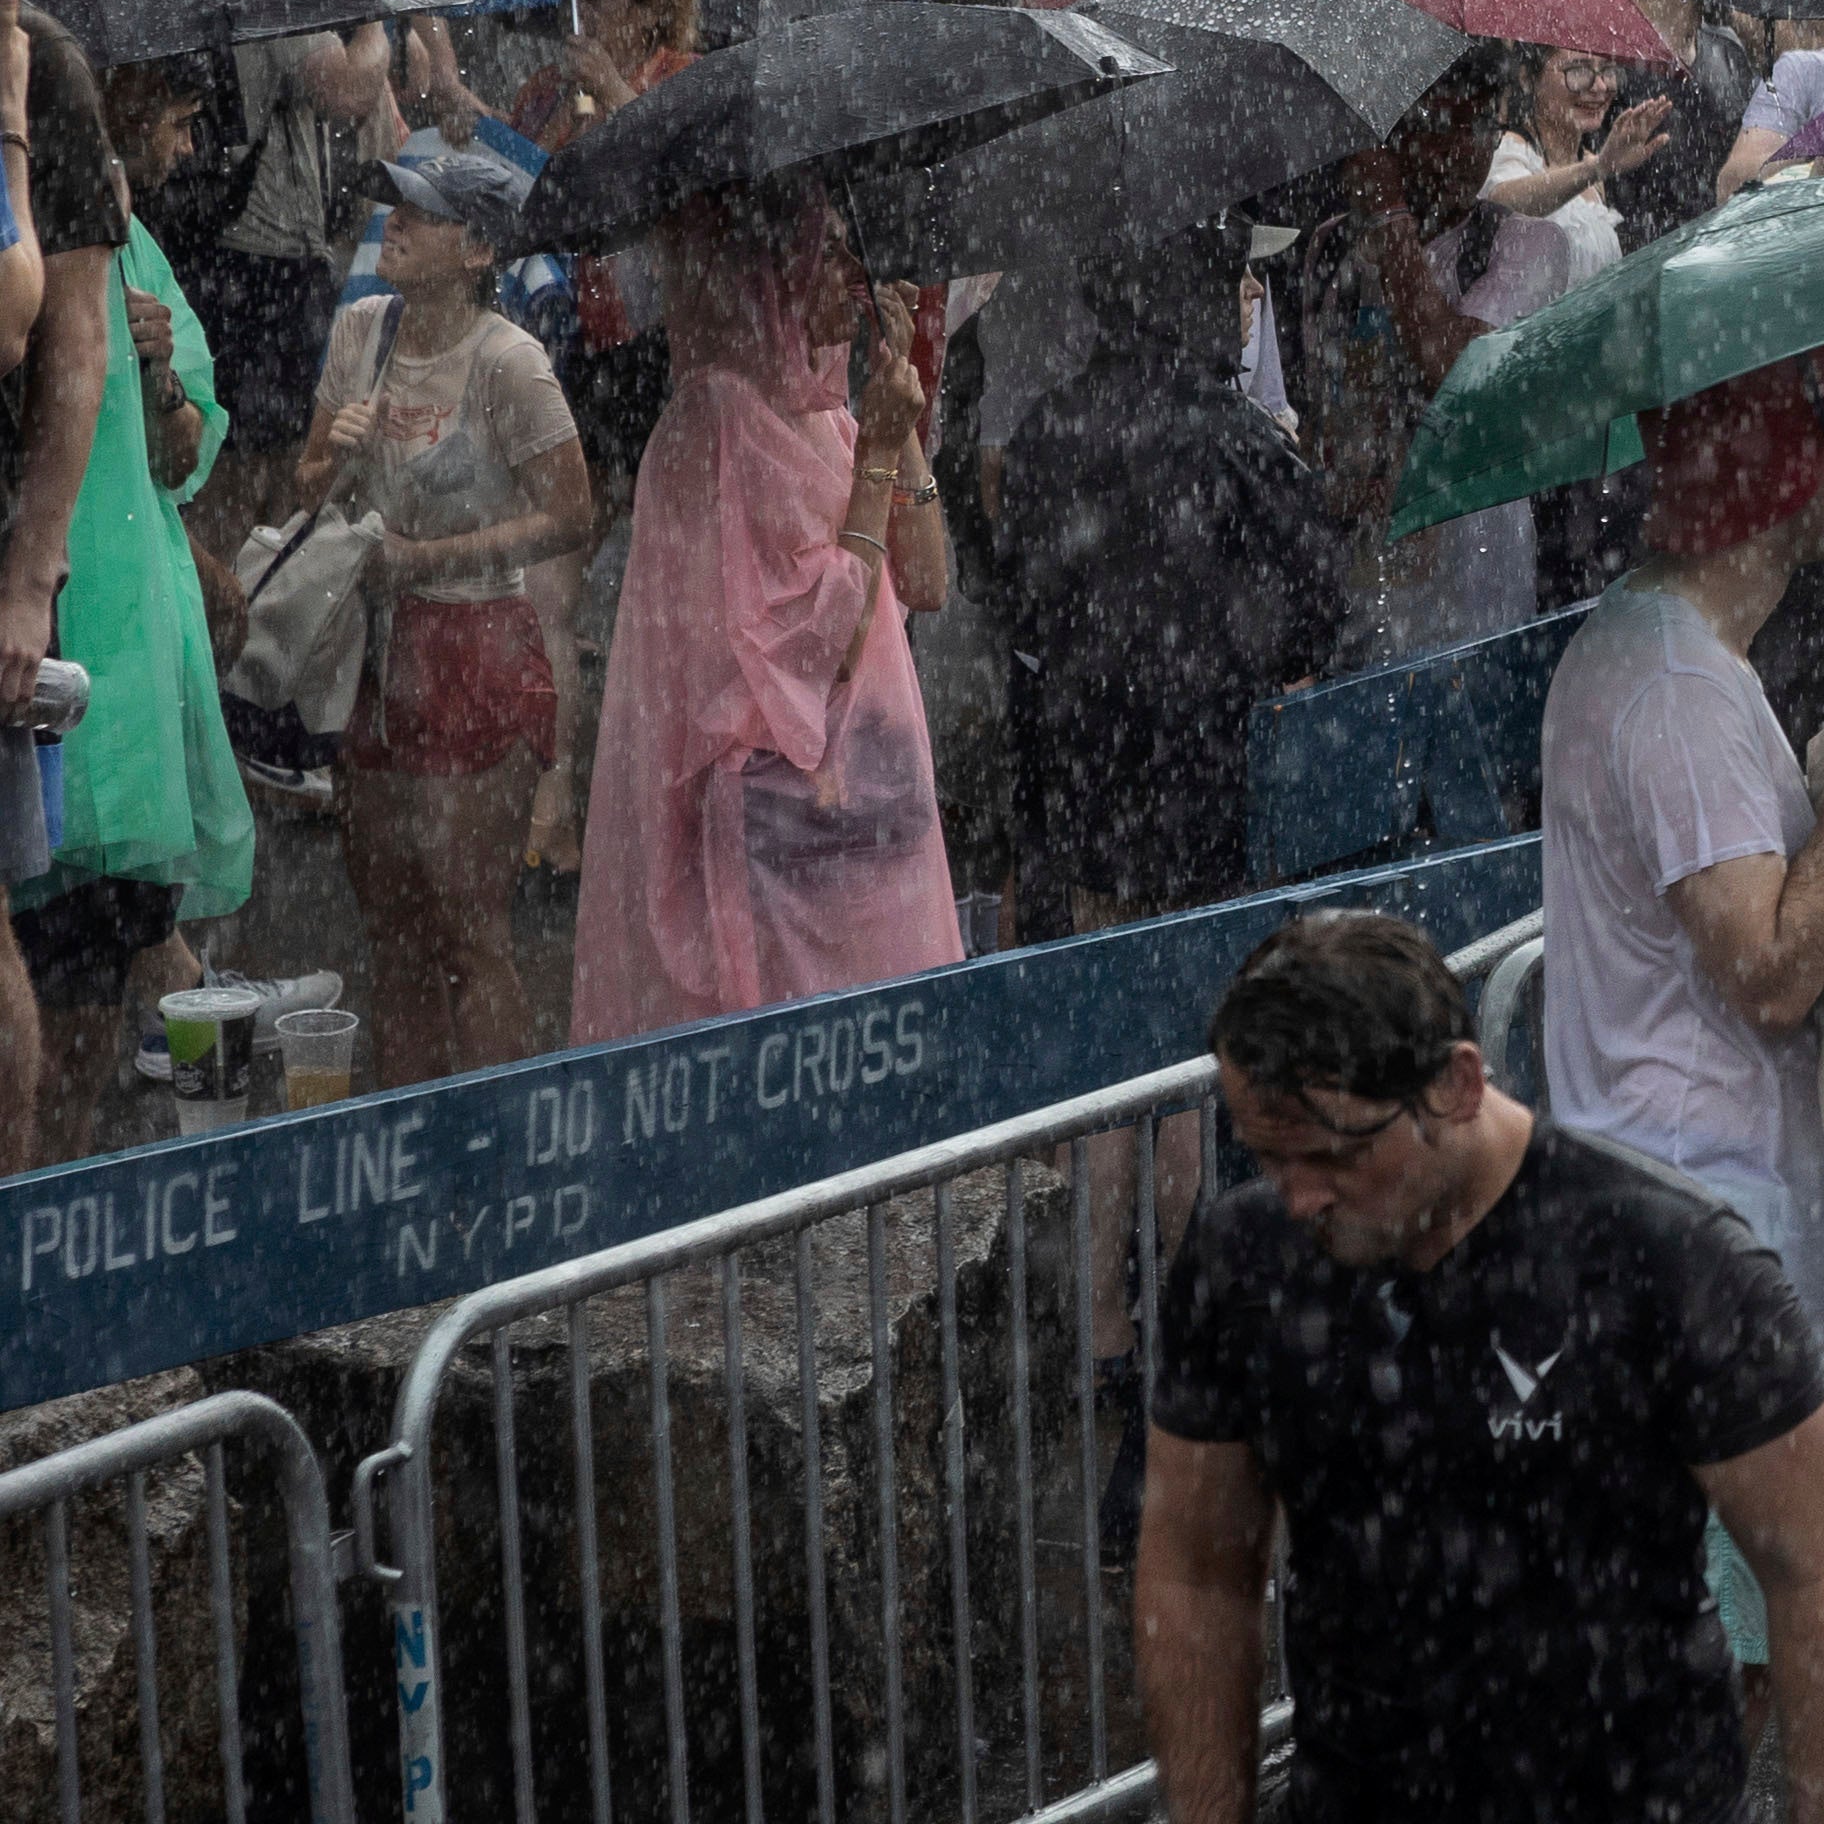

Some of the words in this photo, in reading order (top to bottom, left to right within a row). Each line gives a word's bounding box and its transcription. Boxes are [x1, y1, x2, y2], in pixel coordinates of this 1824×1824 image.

[21, 1163, 238, 1291] POLICE
[298, 1116, 426, 1225] LINE
[526, 1077, 596, 1168] DO
[623, 1045, 731, 1144] NOT
[756, 1000, 925, 1109] CROSS
[398, 1183, 595, 1278] NYPD
[1487, 1409, 1562, 1442] vivi
